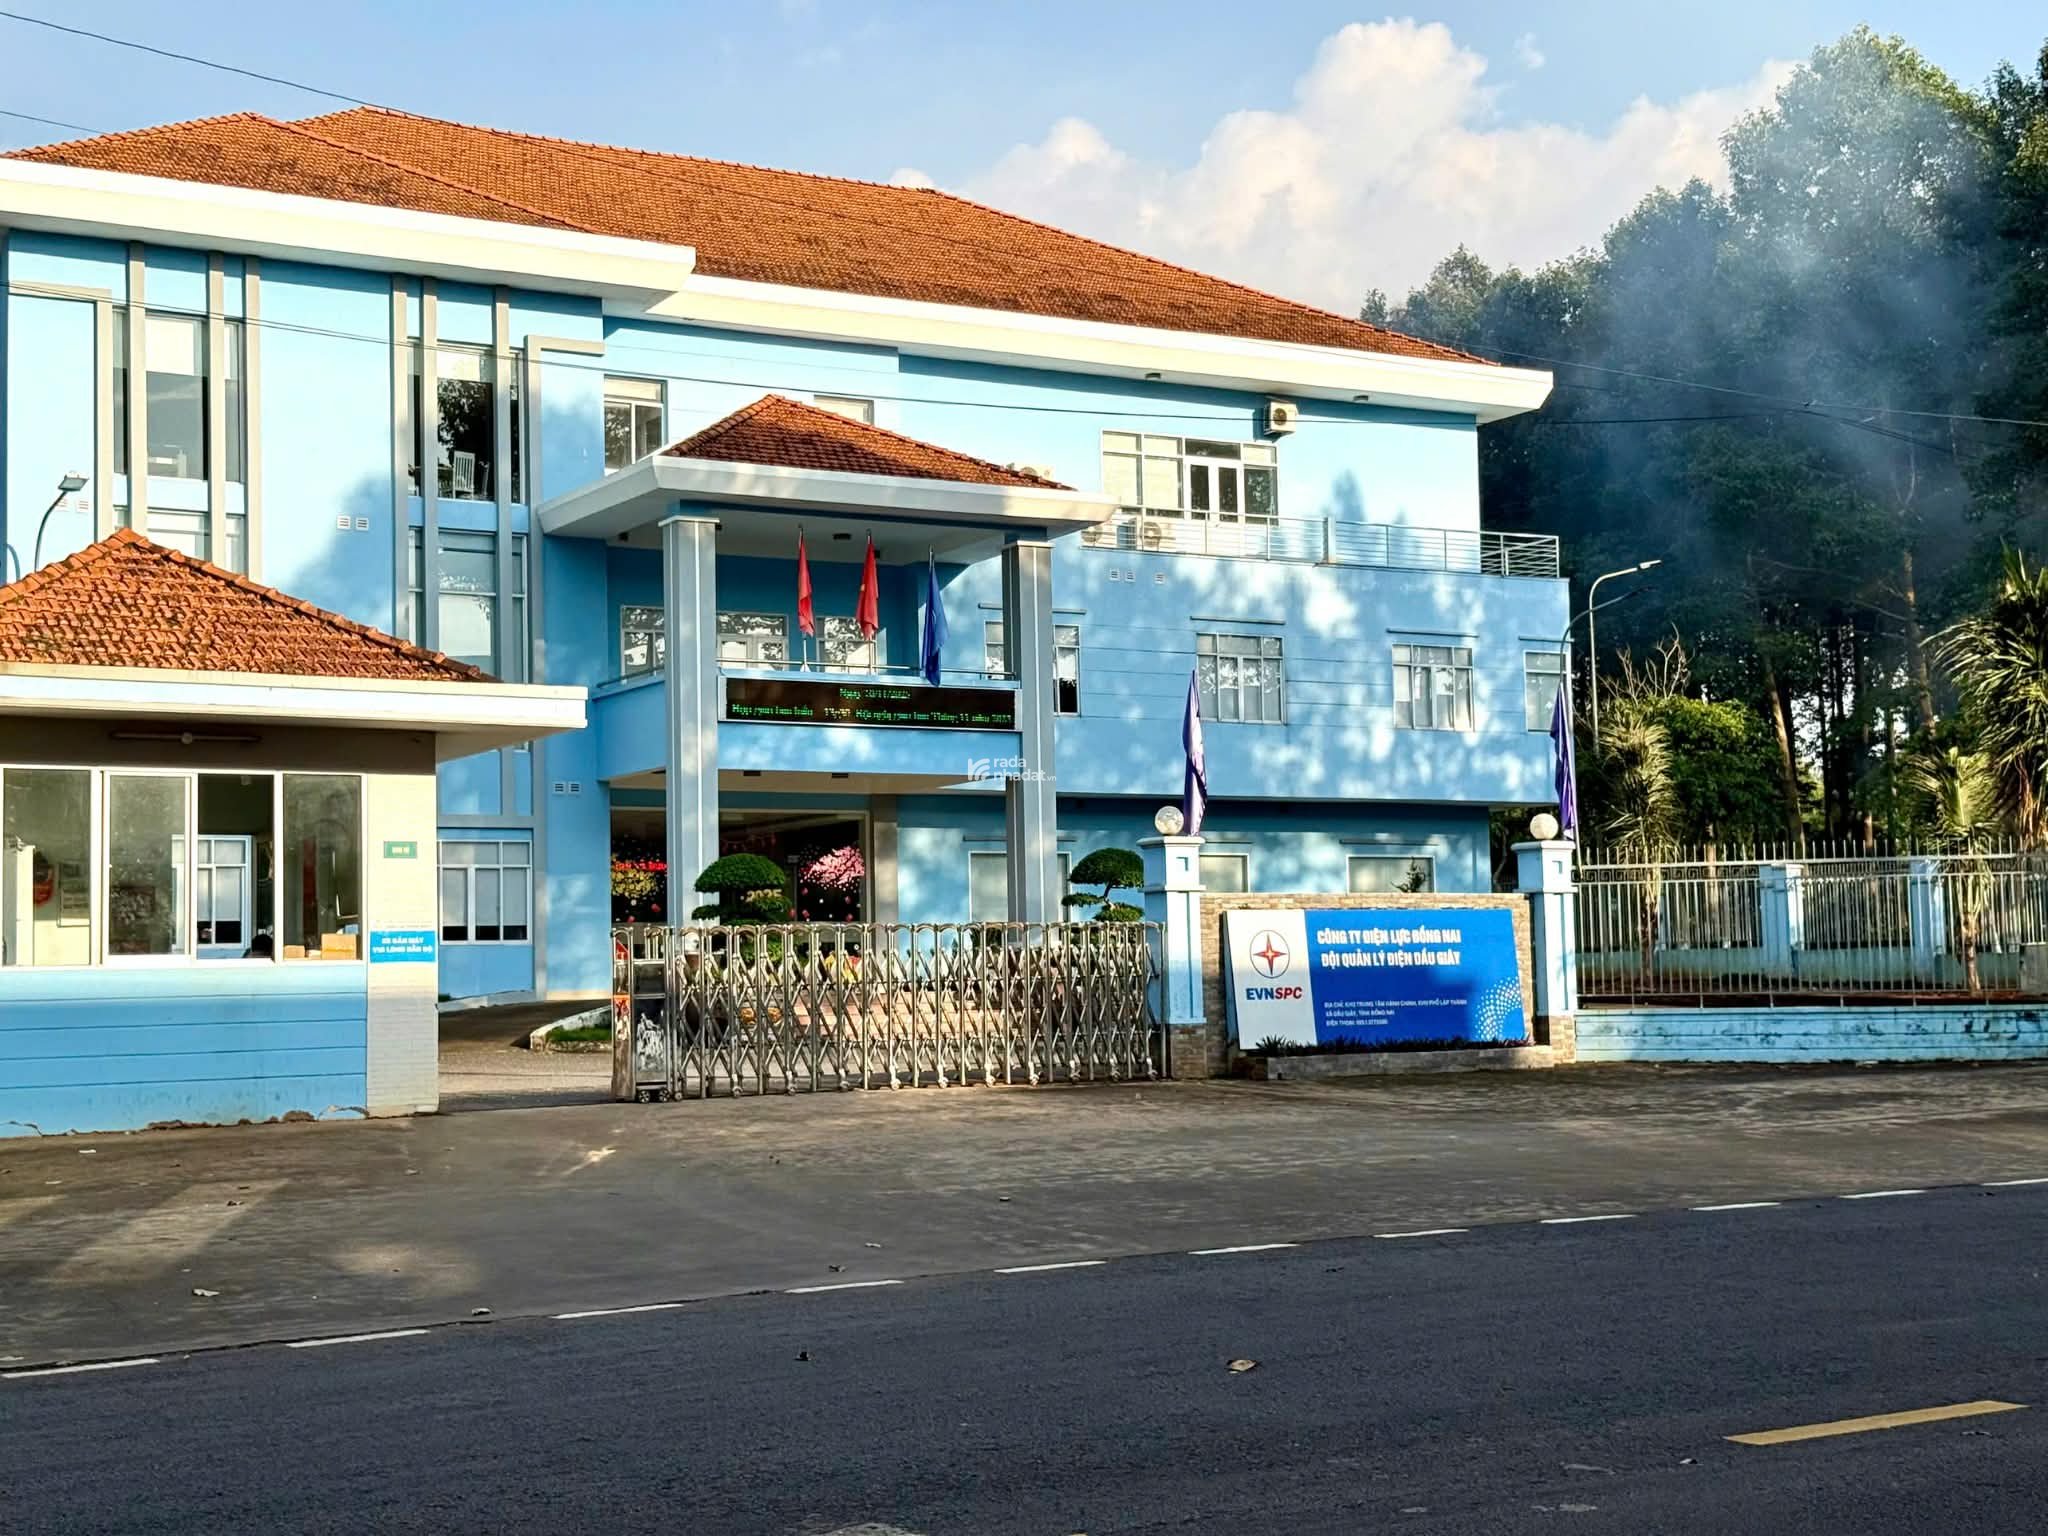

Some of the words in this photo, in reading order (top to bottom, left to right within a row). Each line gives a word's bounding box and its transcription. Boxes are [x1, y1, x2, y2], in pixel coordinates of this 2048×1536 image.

[1317, 927, 1348, 944] CÔNG
[1348, 929, 1361, 944] TY
[1362, 927, 1389, 946] ĐIỆN
[1390, 928, 1411, 946] LỰC
[1442, 929, 1462, 943] NAI
[1321, 950, 1340, 969] ĐỘI
[1341, 948, 1371, 968] QUẢN
[1373, 949, 1386, 966] LÝ
[1387, 949, 1413, 968] ĐIỆN
[1246, 986, 1303, 1001] EVNSPC
